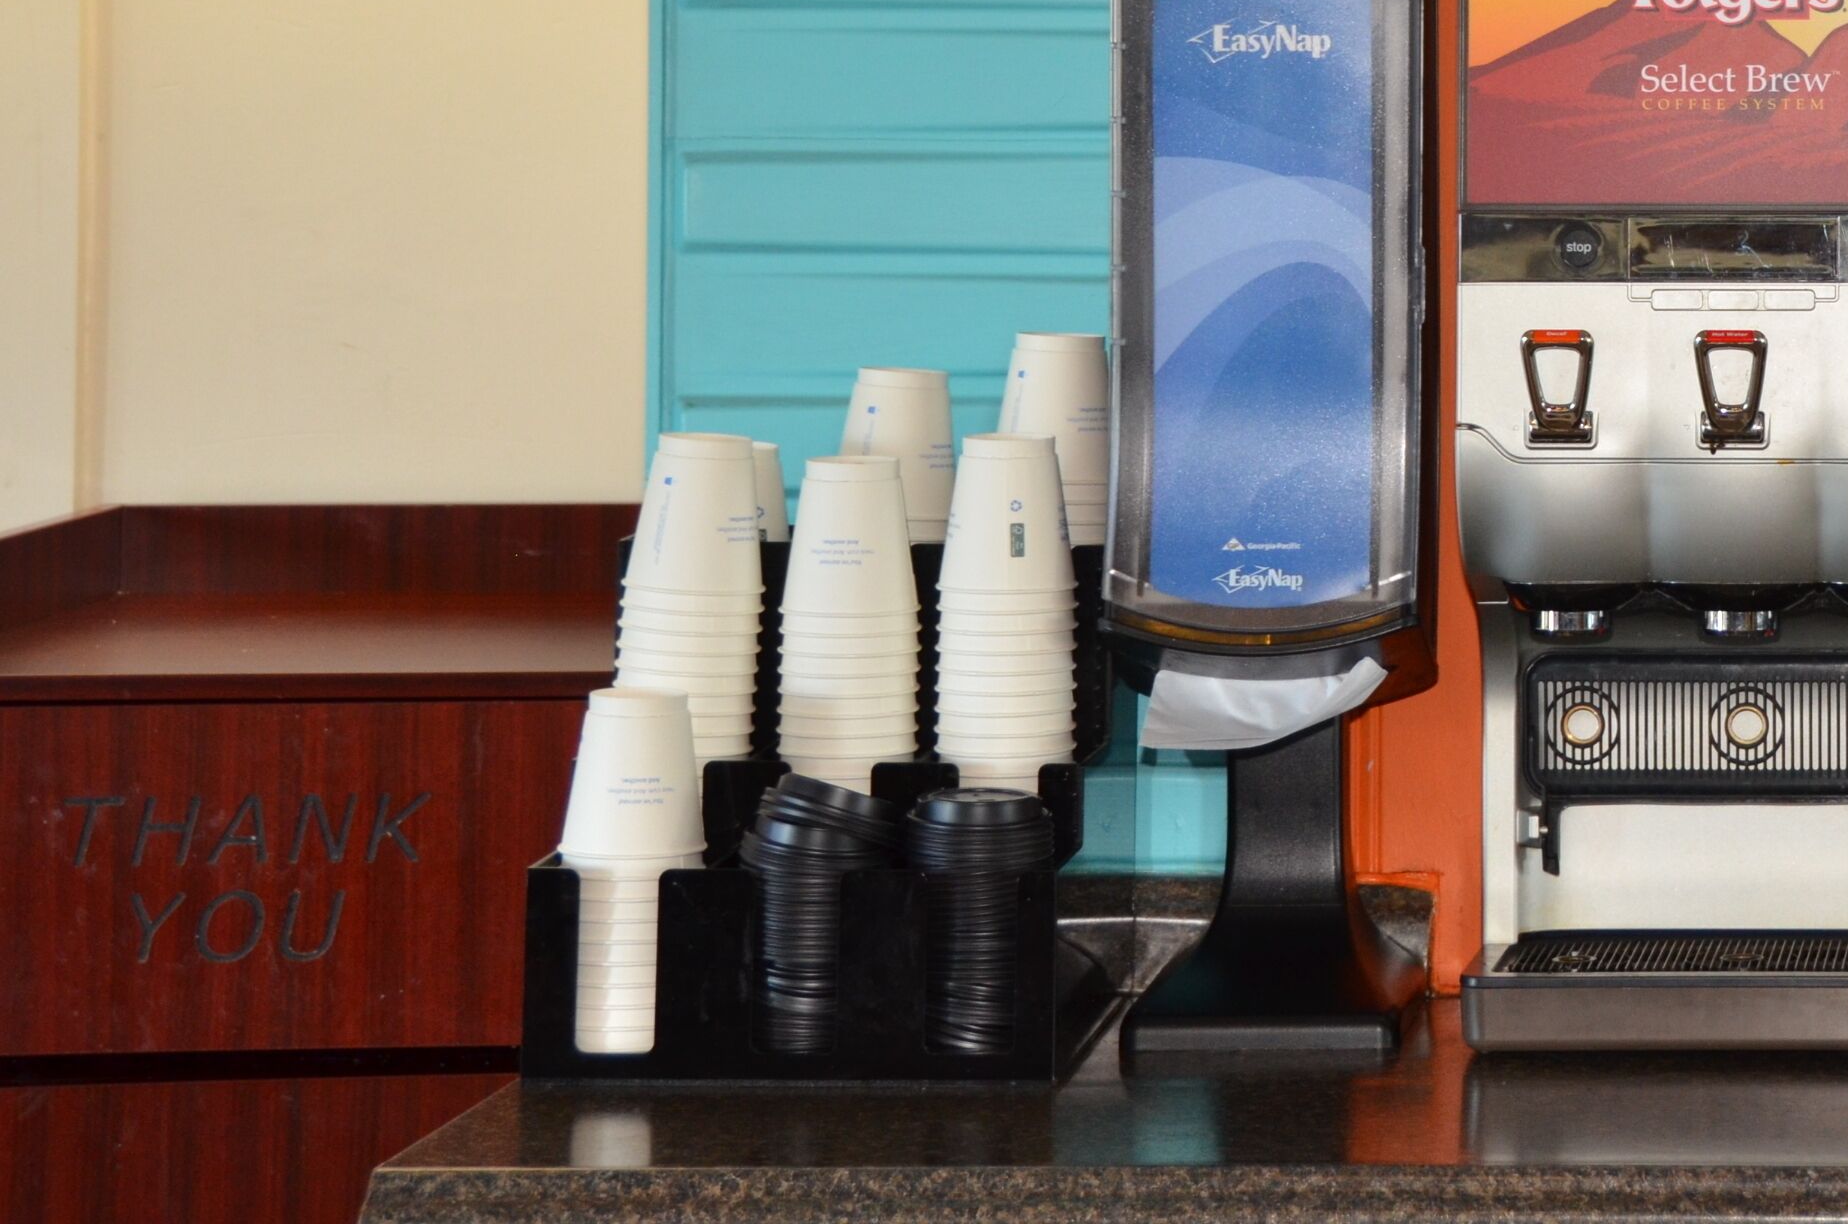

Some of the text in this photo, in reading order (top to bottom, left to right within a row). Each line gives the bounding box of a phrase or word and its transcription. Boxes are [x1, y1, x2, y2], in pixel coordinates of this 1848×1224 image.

[1213, 24, 1332, 58] EasyNap
[1641, 64, 1736, 92] Select
[1641, 98, 1825, 111] COFFEE SYSTEM
[1566, 241, 1592, 255] stop
[1247, 542, 1301, 551] Georgia-Pacific
[1228, 568, 1303, 591] EasyNap
[64, 792, 432, 866] THANK
[130, 889, 347, 964] YOU
